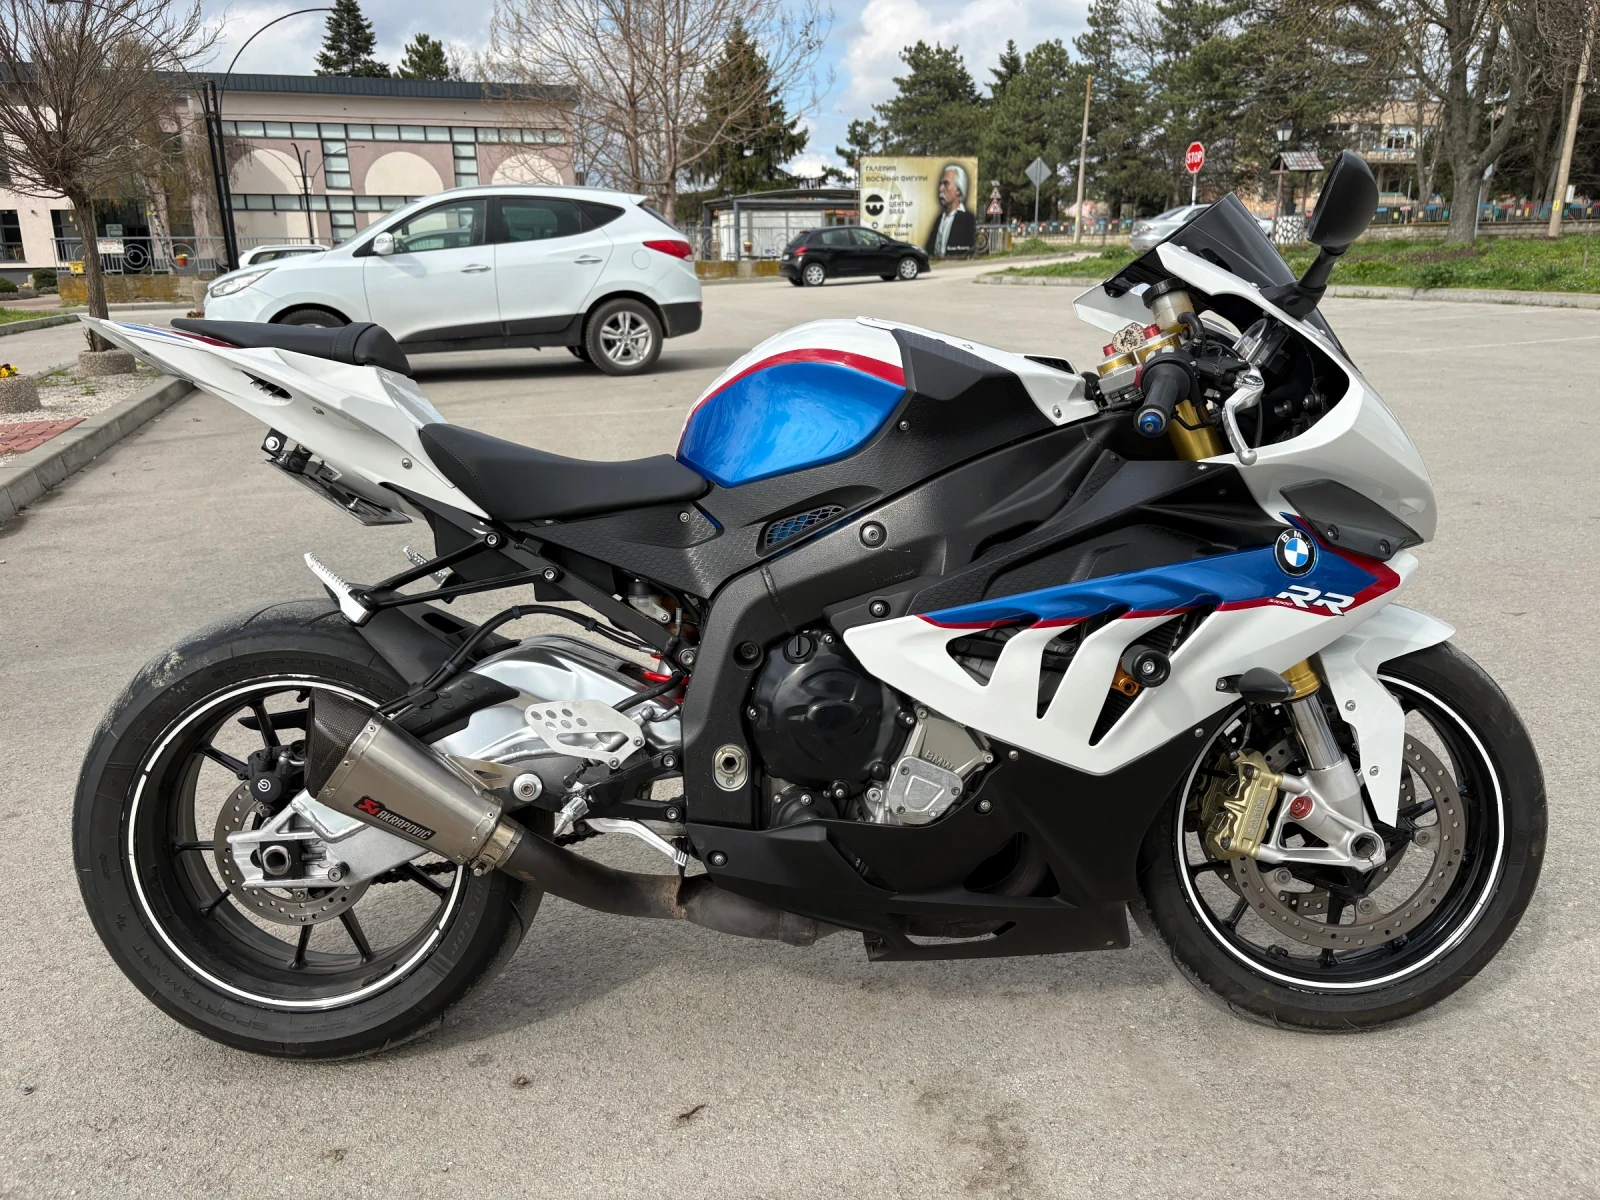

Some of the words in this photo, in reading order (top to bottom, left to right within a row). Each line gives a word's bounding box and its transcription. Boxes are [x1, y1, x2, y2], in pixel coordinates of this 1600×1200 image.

[1187, 150, 1203, 165] STOP
[1275, 584, 1356, 616] RR
[924, 749, 955, 771] BMW
